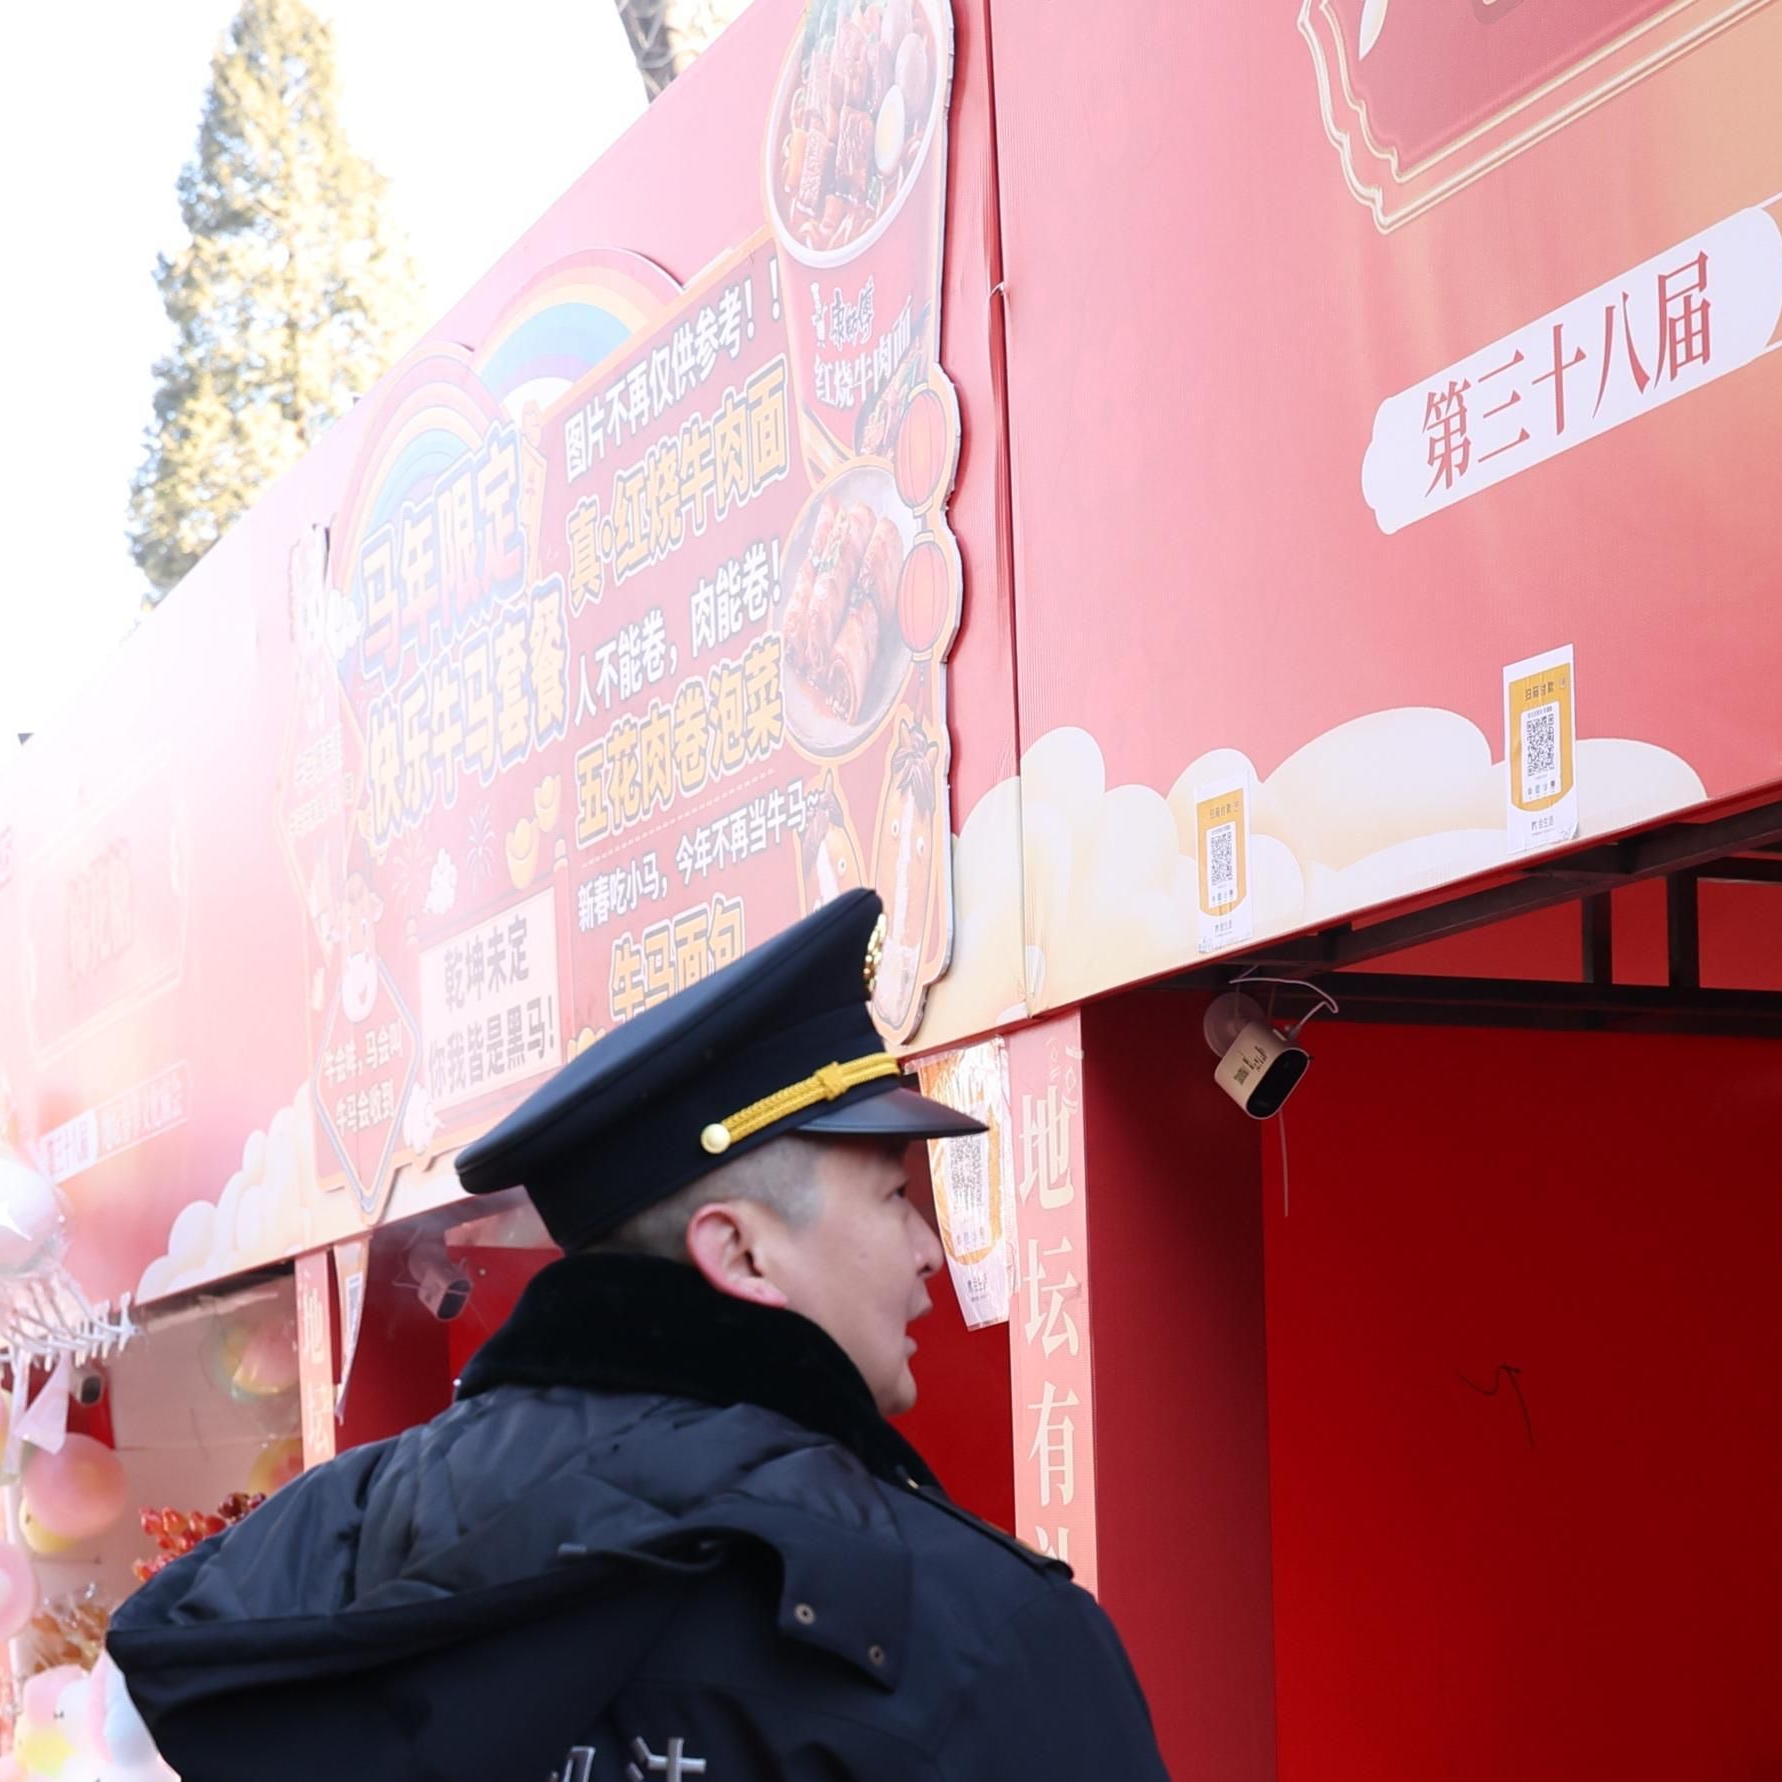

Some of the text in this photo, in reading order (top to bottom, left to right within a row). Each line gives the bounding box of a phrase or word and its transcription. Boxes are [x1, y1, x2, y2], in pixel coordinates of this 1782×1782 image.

[1422, 251, 1712, 499] 第三十八届
[367, 585, 569, 846] 快乐牛马套餐
[576, 634, 785, 848] 五花肉卷泡菜
[444, 914, 529, 1014] 乾坤未定
